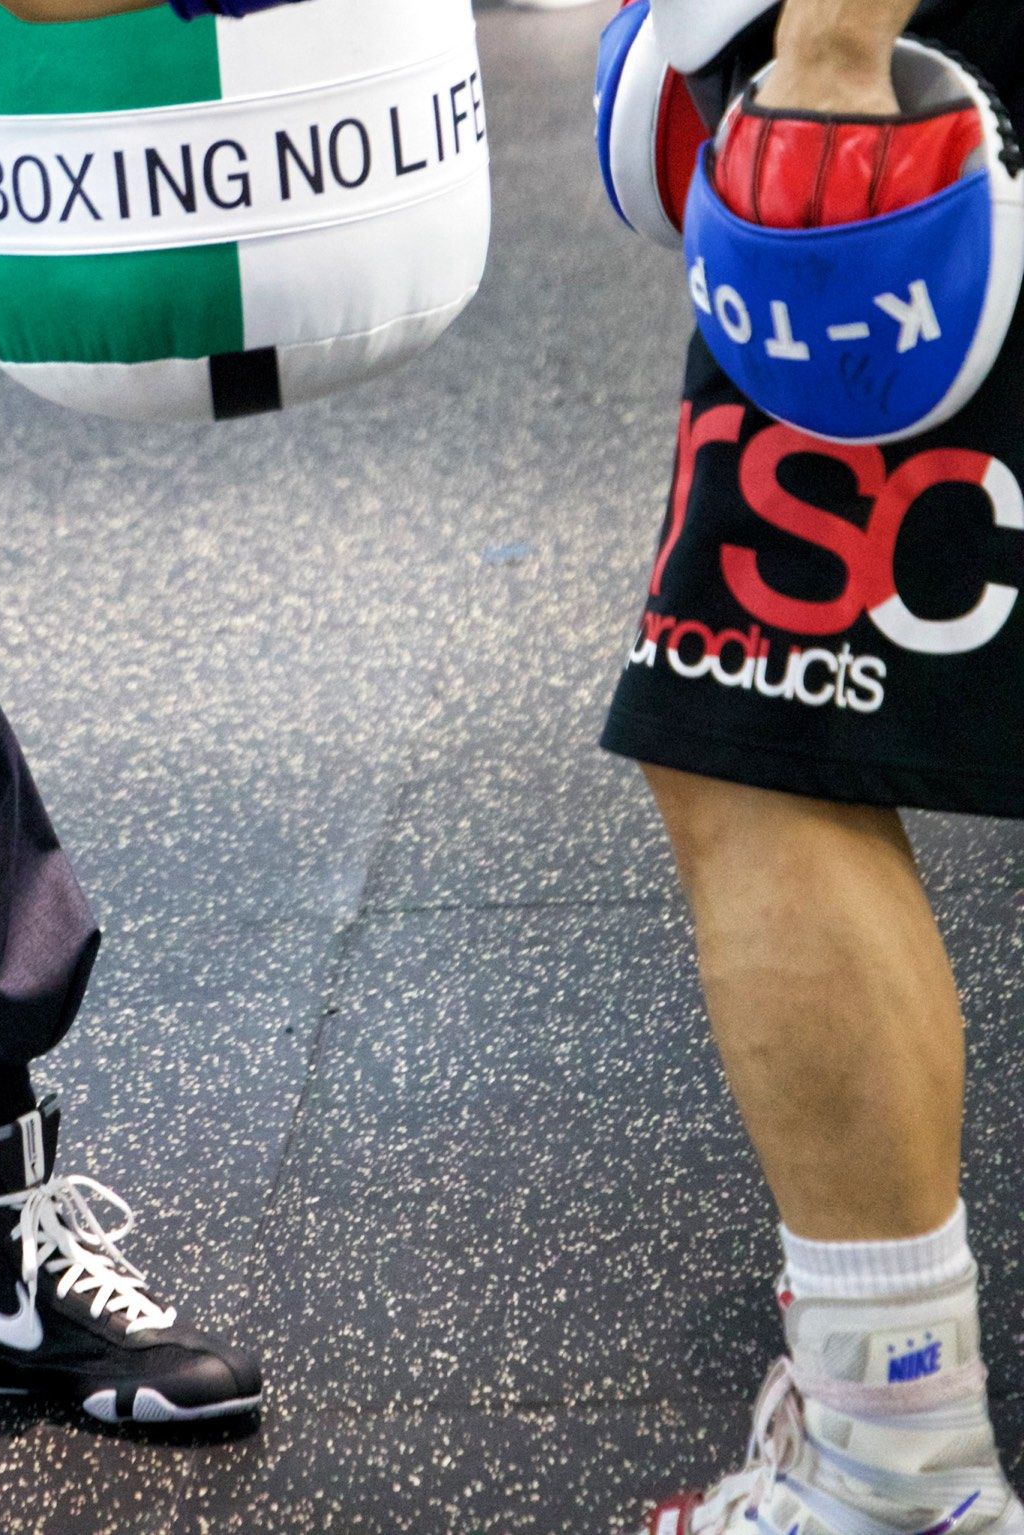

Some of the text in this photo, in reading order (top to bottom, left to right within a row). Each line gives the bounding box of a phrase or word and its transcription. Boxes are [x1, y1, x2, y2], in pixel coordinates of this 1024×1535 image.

[275, 118, 372, 201] NO
[389, 72, 485, 177] LIFE
[887, 1340, 943, 1383] NIKE
